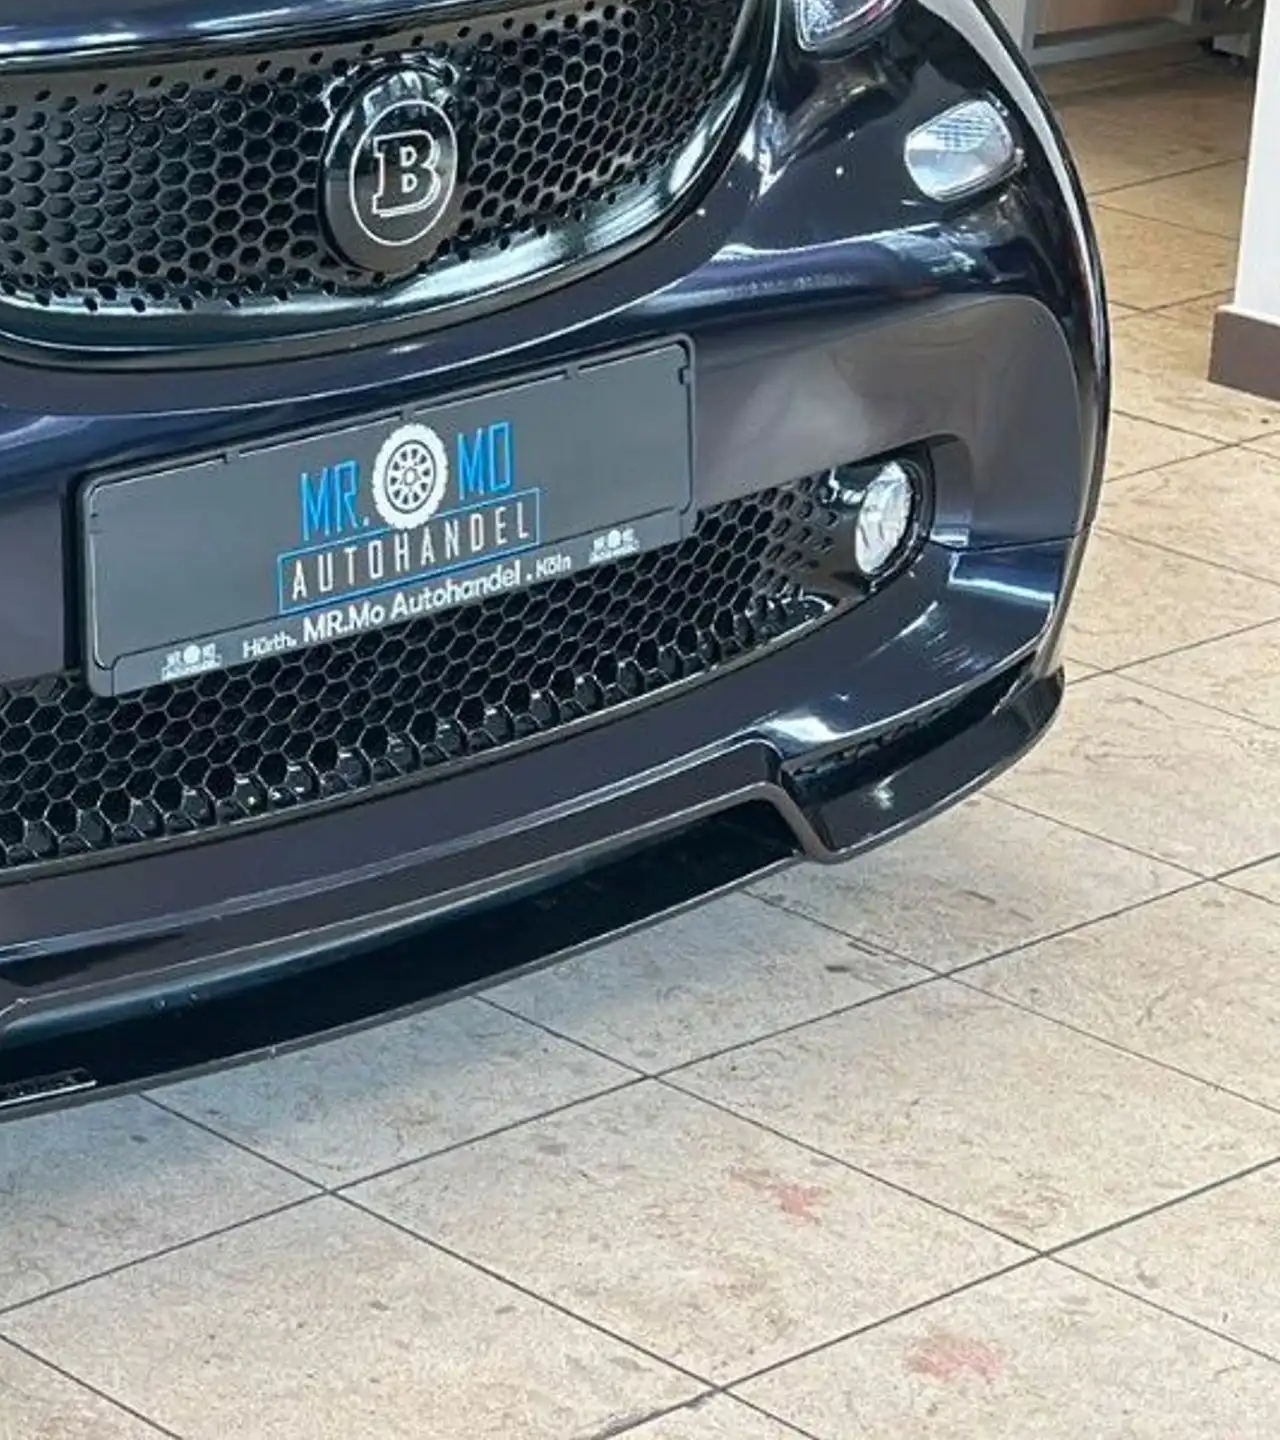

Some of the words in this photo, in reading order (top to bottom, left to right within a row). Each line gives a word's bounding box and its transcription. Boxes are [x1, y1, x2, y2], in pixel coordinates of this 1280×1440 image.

[373, 129, 441, 217] B
[301, 460, 369, 541] MR.
[457, 421, 512, 501] MO
[292, 501, 528, 601] AUTOHANDEL
[303, 601, 384, 643] MR.Mo
[390, 559, 521, 620] Autohandel
[536, 553, 571, 579] Köln
